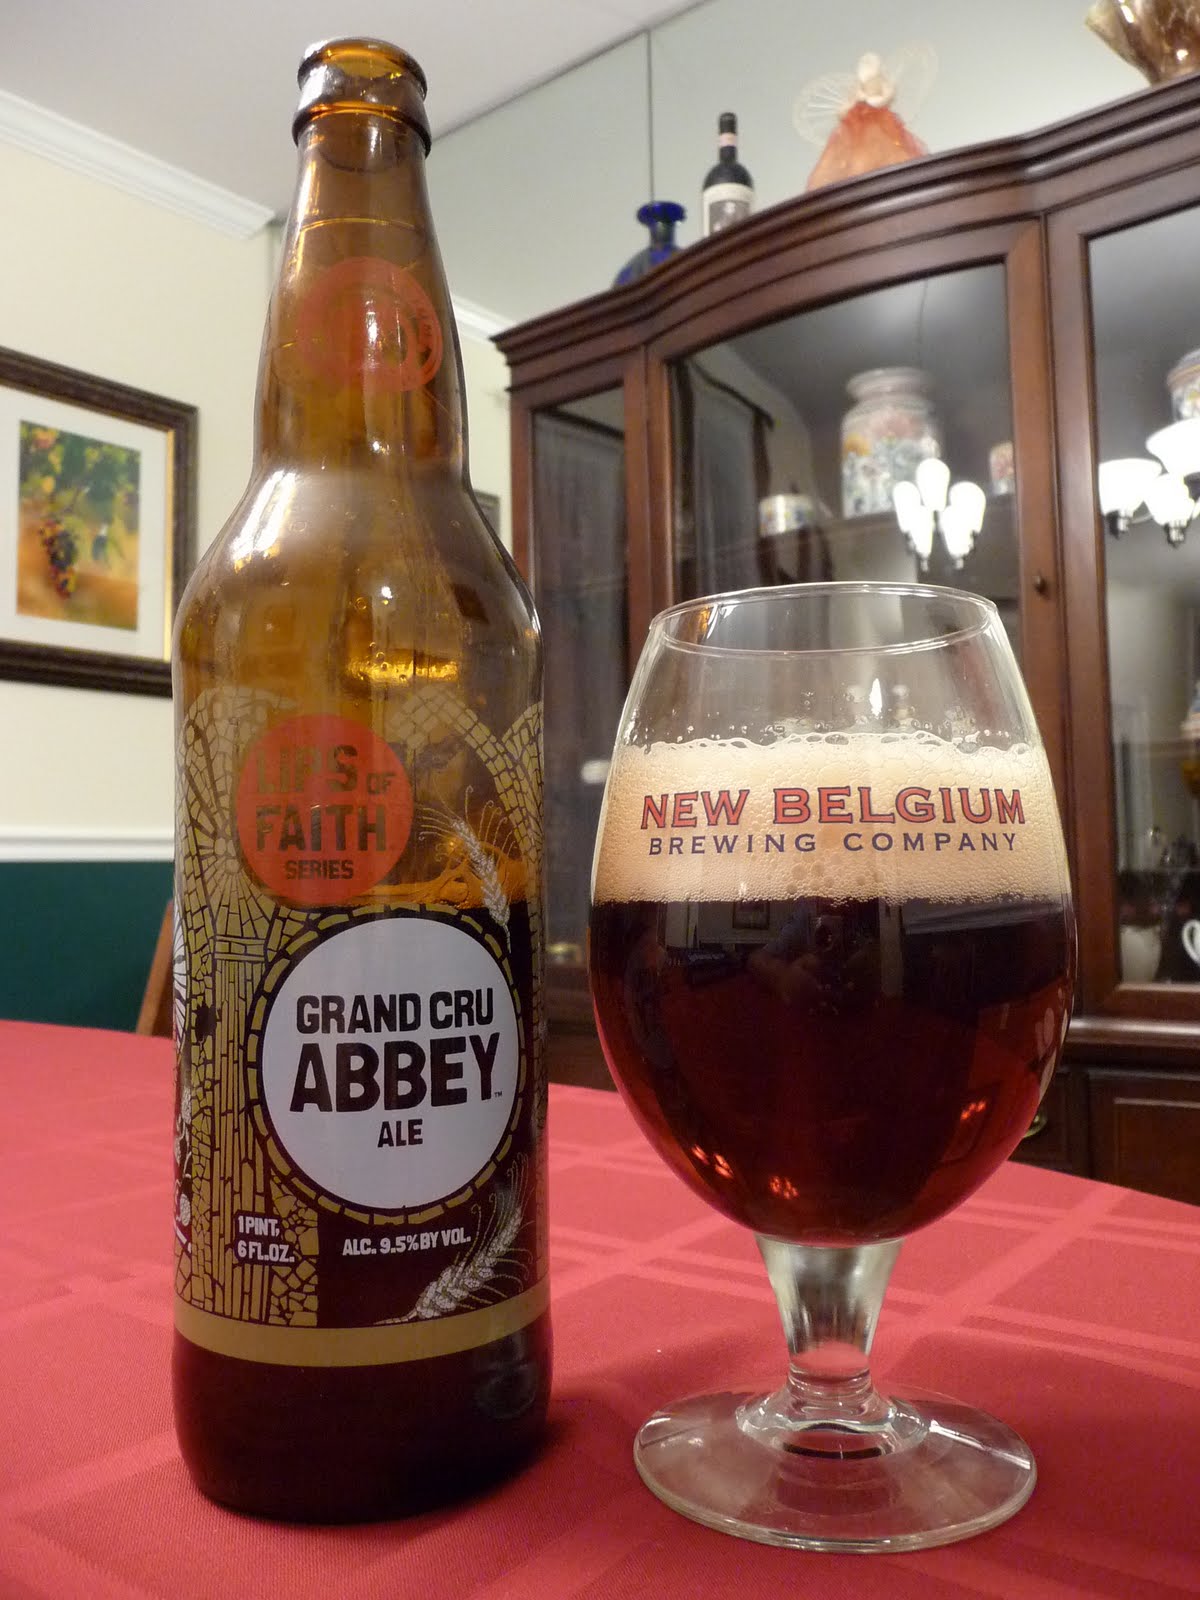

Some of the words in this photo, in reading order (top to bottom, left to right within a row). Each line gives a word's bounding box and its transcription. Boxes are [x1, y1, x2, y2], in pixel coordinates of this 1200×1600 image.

[254, 745, 358, 794] LIPS
[366, 772, 396, 795] OF
[255, 804, 387, 852] FAITH
[640, 788, 750, 830] NEW
[773, 785, 1026, 826] BELGIUM
[648, 832, 817, 856] BREWING
[843, 831, 1017, 853] COMPANY
[284, 859, 355, 880] SERIES
[296, 992, 422, 1035] GRAND
[429, 987, 494, 1030] CRU
[289, 1032, 501, 1113] ABBEY
[377, 1118, 424, 1149] ALE
[342, 1237, 377, 1256] ALC.
[441, 1227, 472, 1247] VOL.
